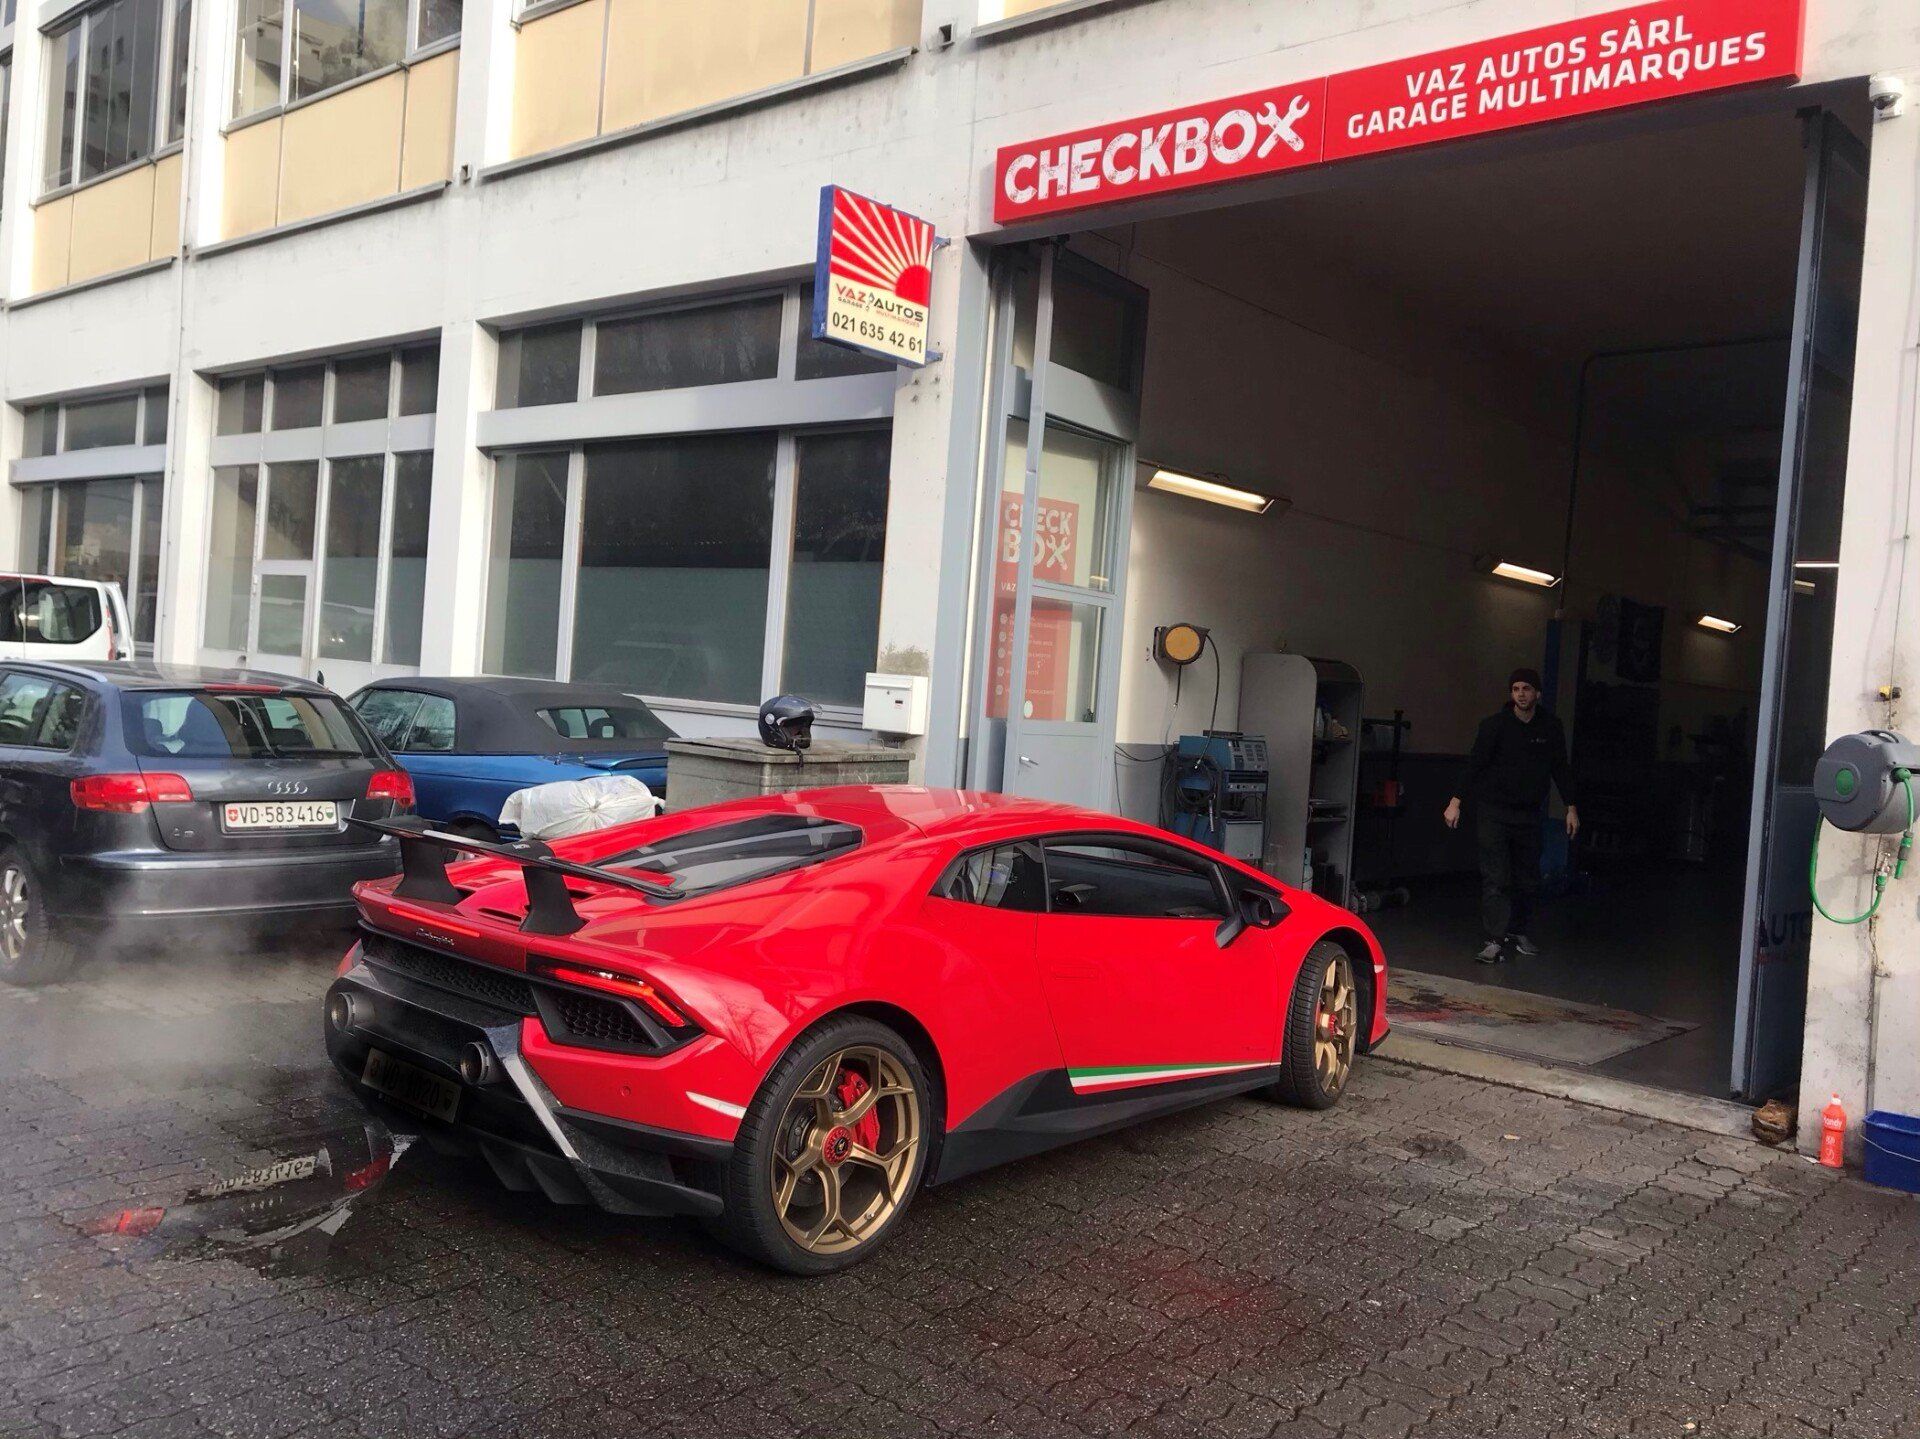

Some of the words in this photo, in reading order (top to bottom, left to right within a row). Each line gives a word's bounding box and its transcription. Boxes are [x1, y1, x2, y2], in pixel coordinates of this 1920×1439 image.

[1347, 92, 1467, 139] GARAGE
[1478, 31, 1767, 115] MULTIMARQUES
[1406, 62, 1466, 98] VAZ
[1476, 36, 1587, 85] AUTOS
[1599, 15, 1693, 58] SÀRL
[1004, 95, 1310, 204] CHECKBOX
[832, 311, 856, 332] 021
[860, 320, 885, 341] 635
[889, 330, 905, 348] 42
[909, 336, 923, 354] 61
[836, 283, 867, 303] VAZ
[874, 298, 924, 322] AUTOS
[1004, 502, 1073, 536] CECK
